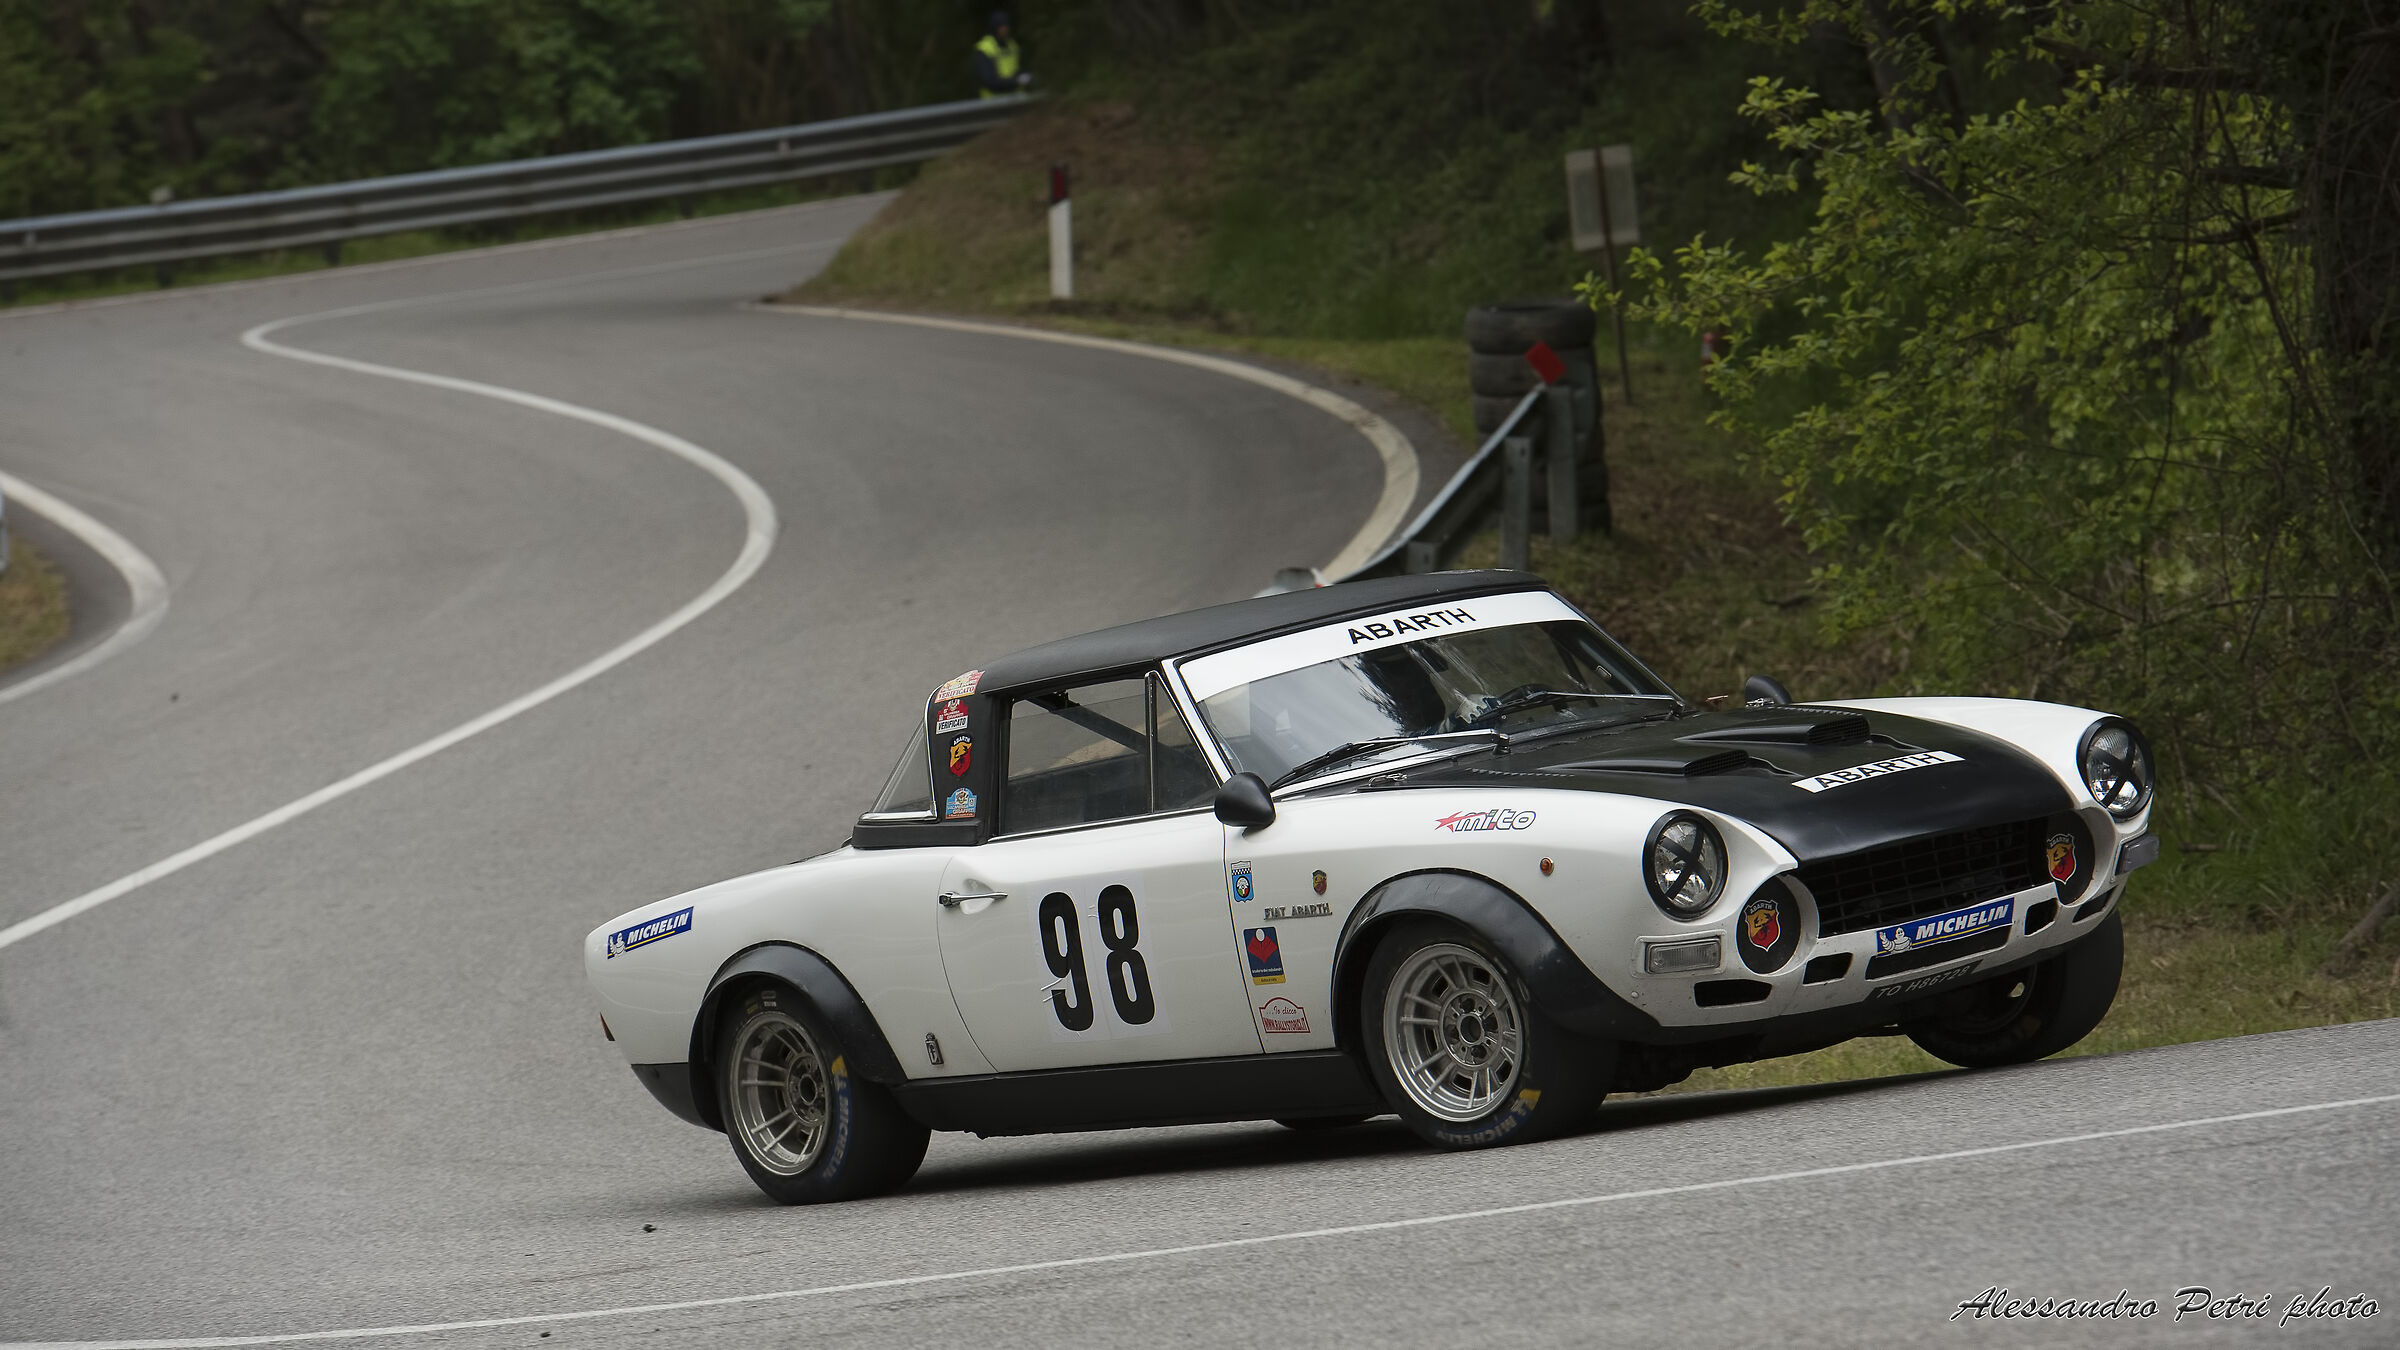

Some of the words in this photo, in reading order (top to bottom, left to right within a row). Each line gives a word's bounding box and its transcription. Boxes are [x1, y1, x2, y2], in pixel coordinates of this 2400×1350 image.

[1348, 608, 1477, 645] ABARTH
[938, 717, 967, 731] VERIFICATO
[1814, 753, 1946, 788] ABARTH
[1264, 906, 1286, 919] FIAT
[1291, 902, 1330, 917] ABARTH
[1749, 903, 1773, 914] ABARTH
[1915, 903, 2010, 941] MICHELIN
[627, 911, 690, 945] MICHELIN
[1038, 884, 1156, 1032] 98
[1876, 985, 1902, 999] TO
